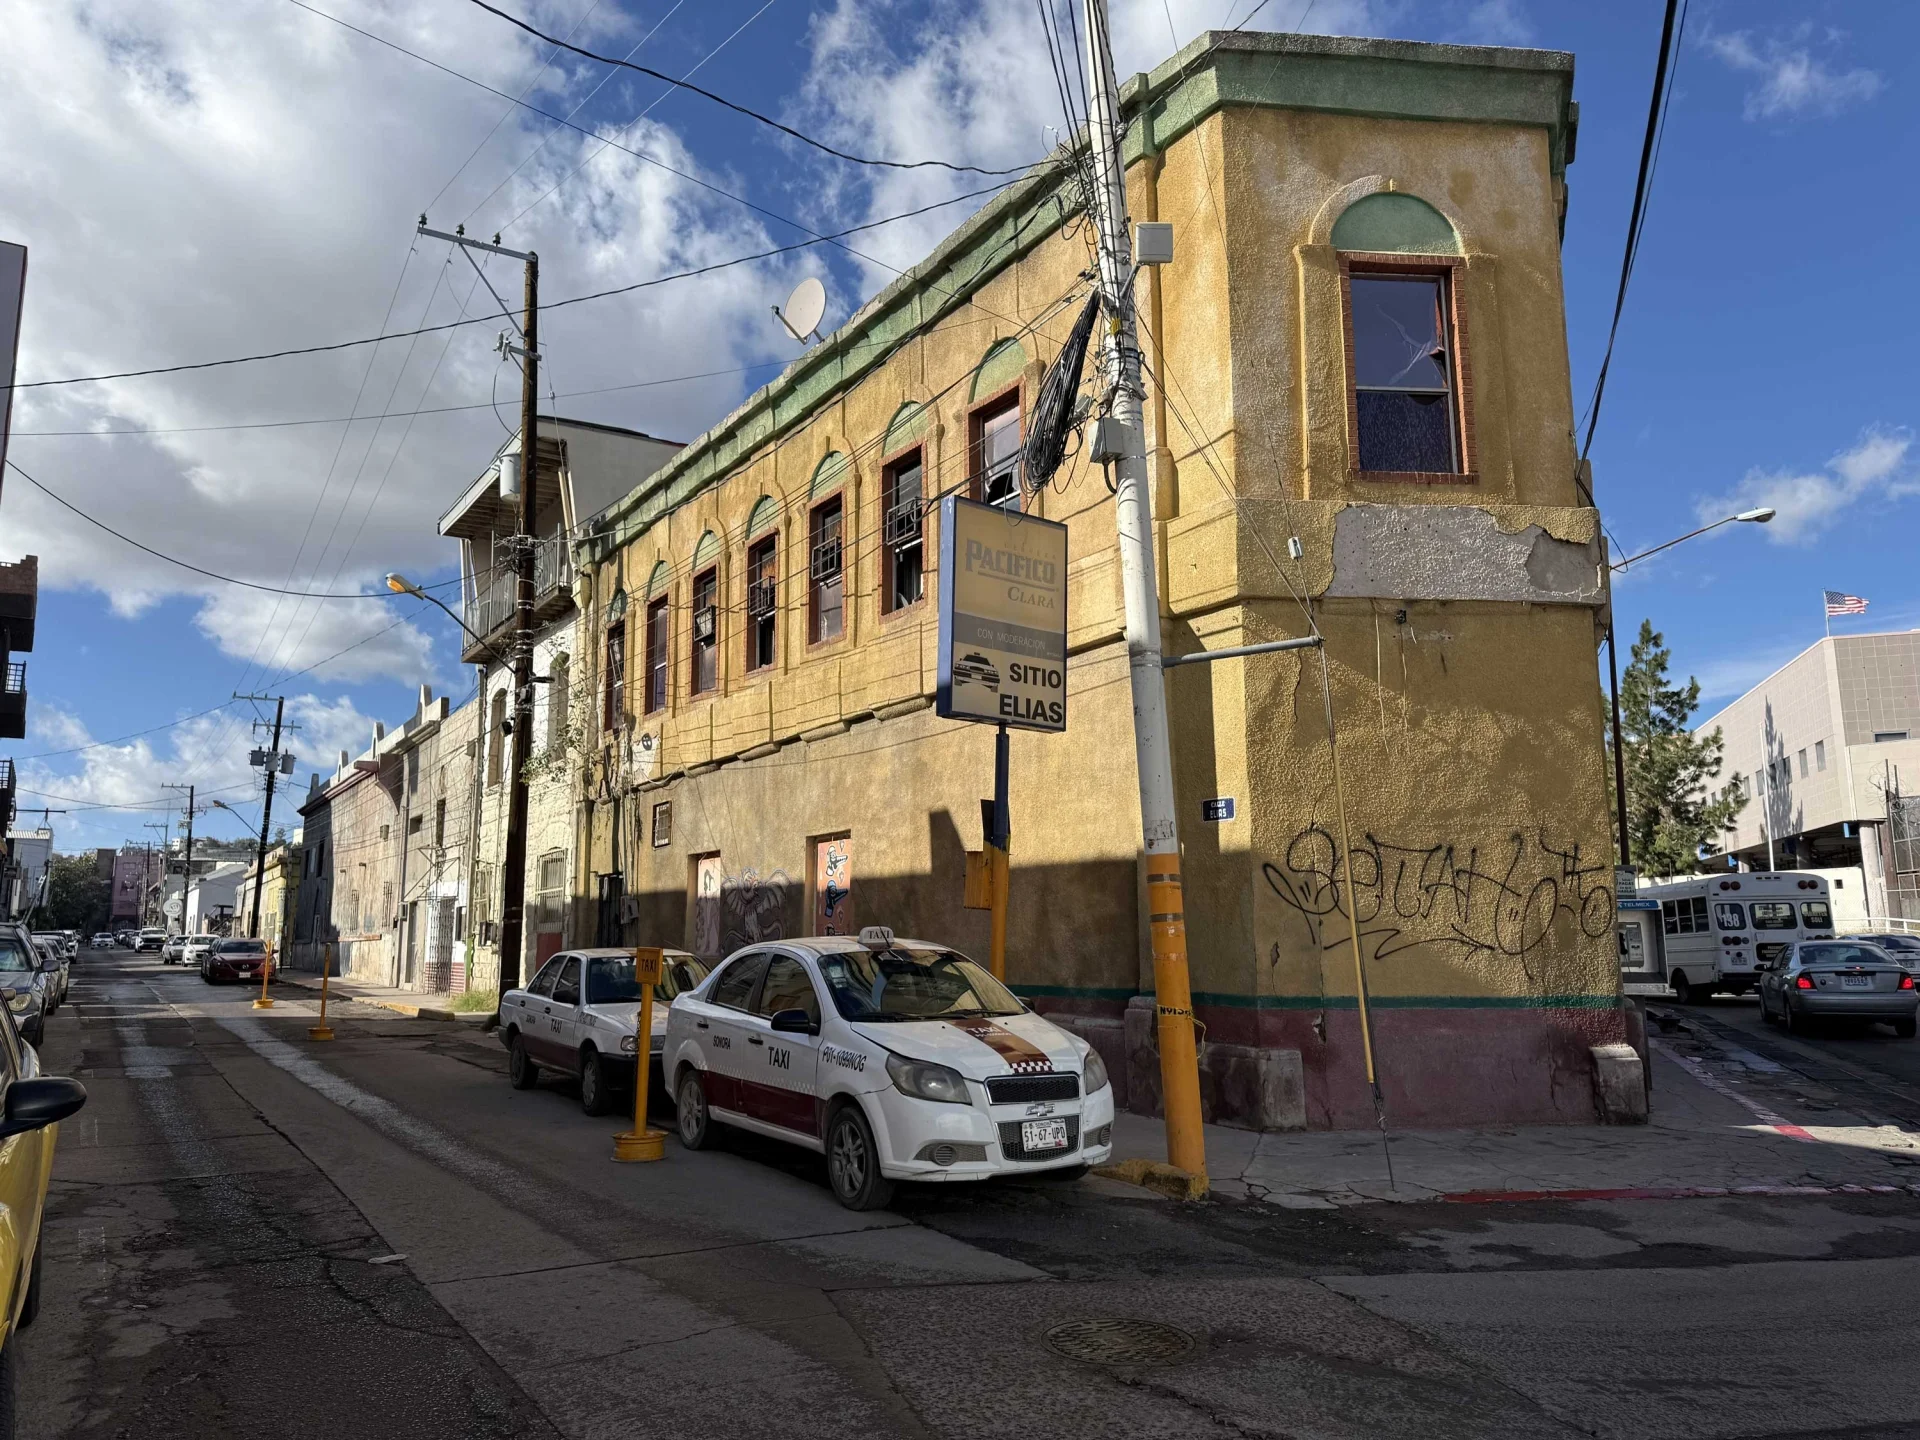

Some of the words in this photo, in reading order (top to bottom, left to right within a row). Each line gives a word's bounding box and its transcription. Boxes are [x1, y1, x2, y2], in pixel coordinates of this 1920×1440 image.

[977, 628, 993, 640] CON
[1010, 662, 1062, 689] SITIO
[1000, 693, 1063, 723] ELIAS
[868, 930, 890, 939] TAXI
[641, 958, 657, 973] TAXI
[550, 1018, 562, 1034] TAXI
[966, 1026, 1003, 1034] TAXI
[713, 1035, 731, 1050] SONORA
[768, 1046, 791, 1070] TAXI
